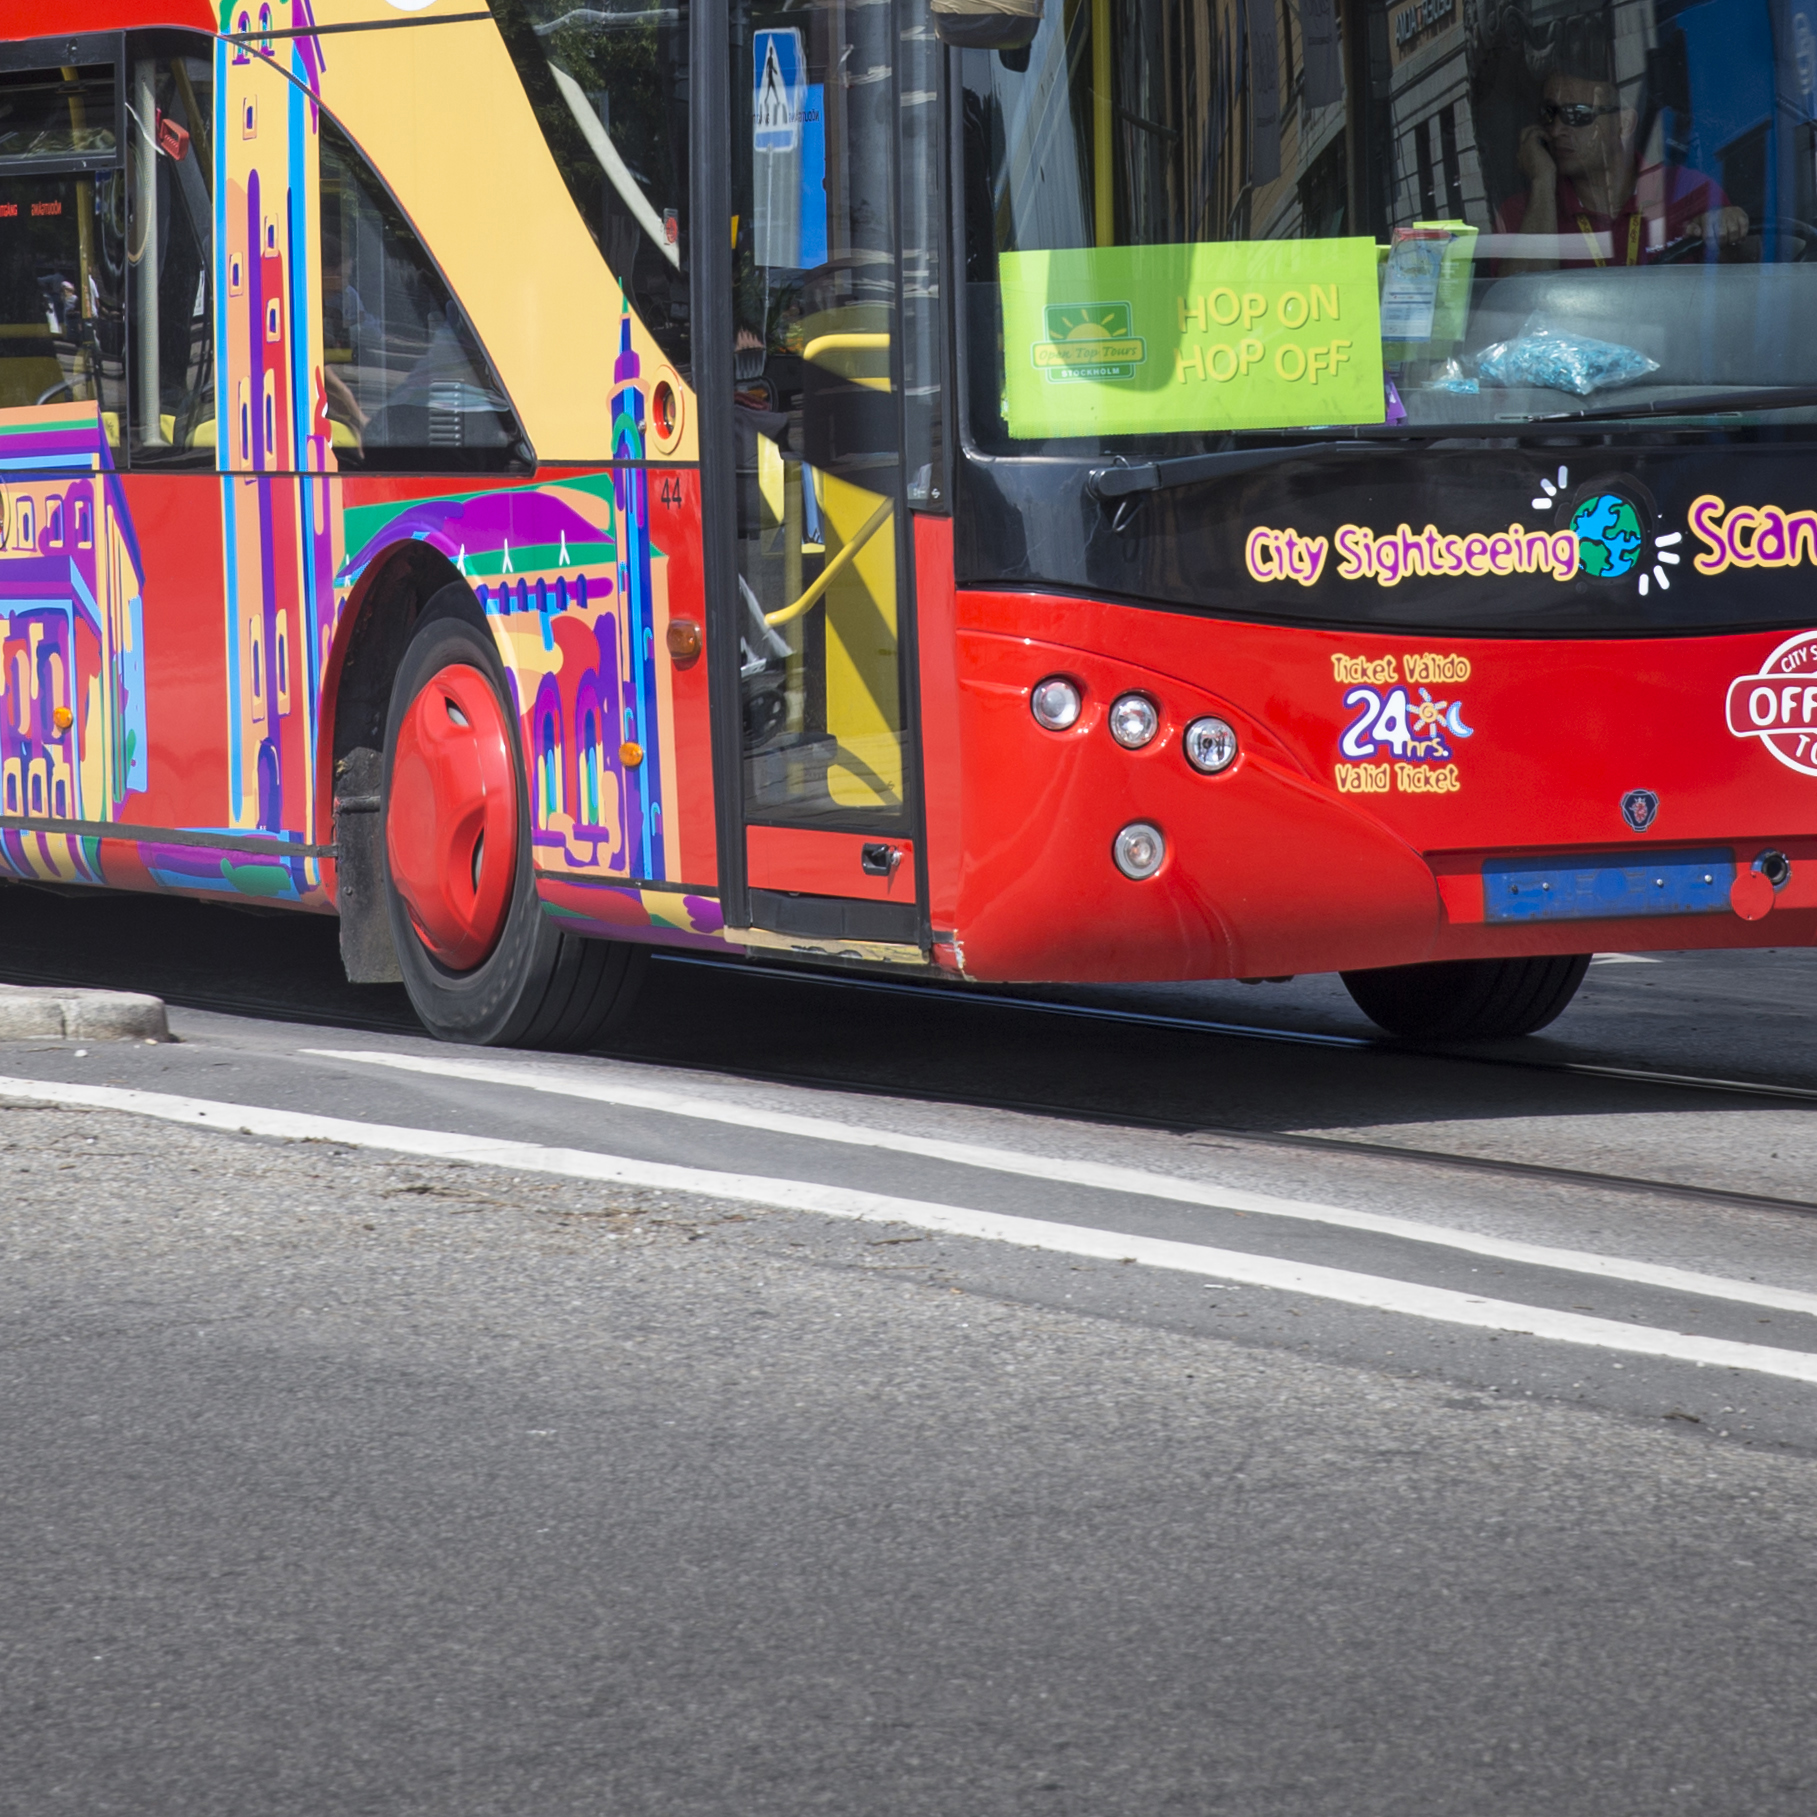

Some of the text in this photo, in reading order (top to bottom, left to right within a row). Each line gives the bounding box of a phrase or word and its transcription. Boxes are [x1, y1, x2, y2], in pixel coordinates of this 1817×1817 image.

[1177, 286, 1269, 333] HOP
[1277, 283, 1340, 330] ON
[1038, 345, 1139, 366] Open Top Tours
[1174, 337, 1353, 385] HOP OFF
[1060, 366, 1121, 379] STOCKHOLM
[660, 477, 683, 510] 44
[1245, 525, 1329, 586] City
[1334, 522, 1581, 586] Sightseeing
[1331, 652, 1471, 685] Ticket Válido
[1780, 646, 1808, 674] CITY
[1341, 687, 1412, 757] 24
[1335, 762, 1461, 794] Valid Ticket
